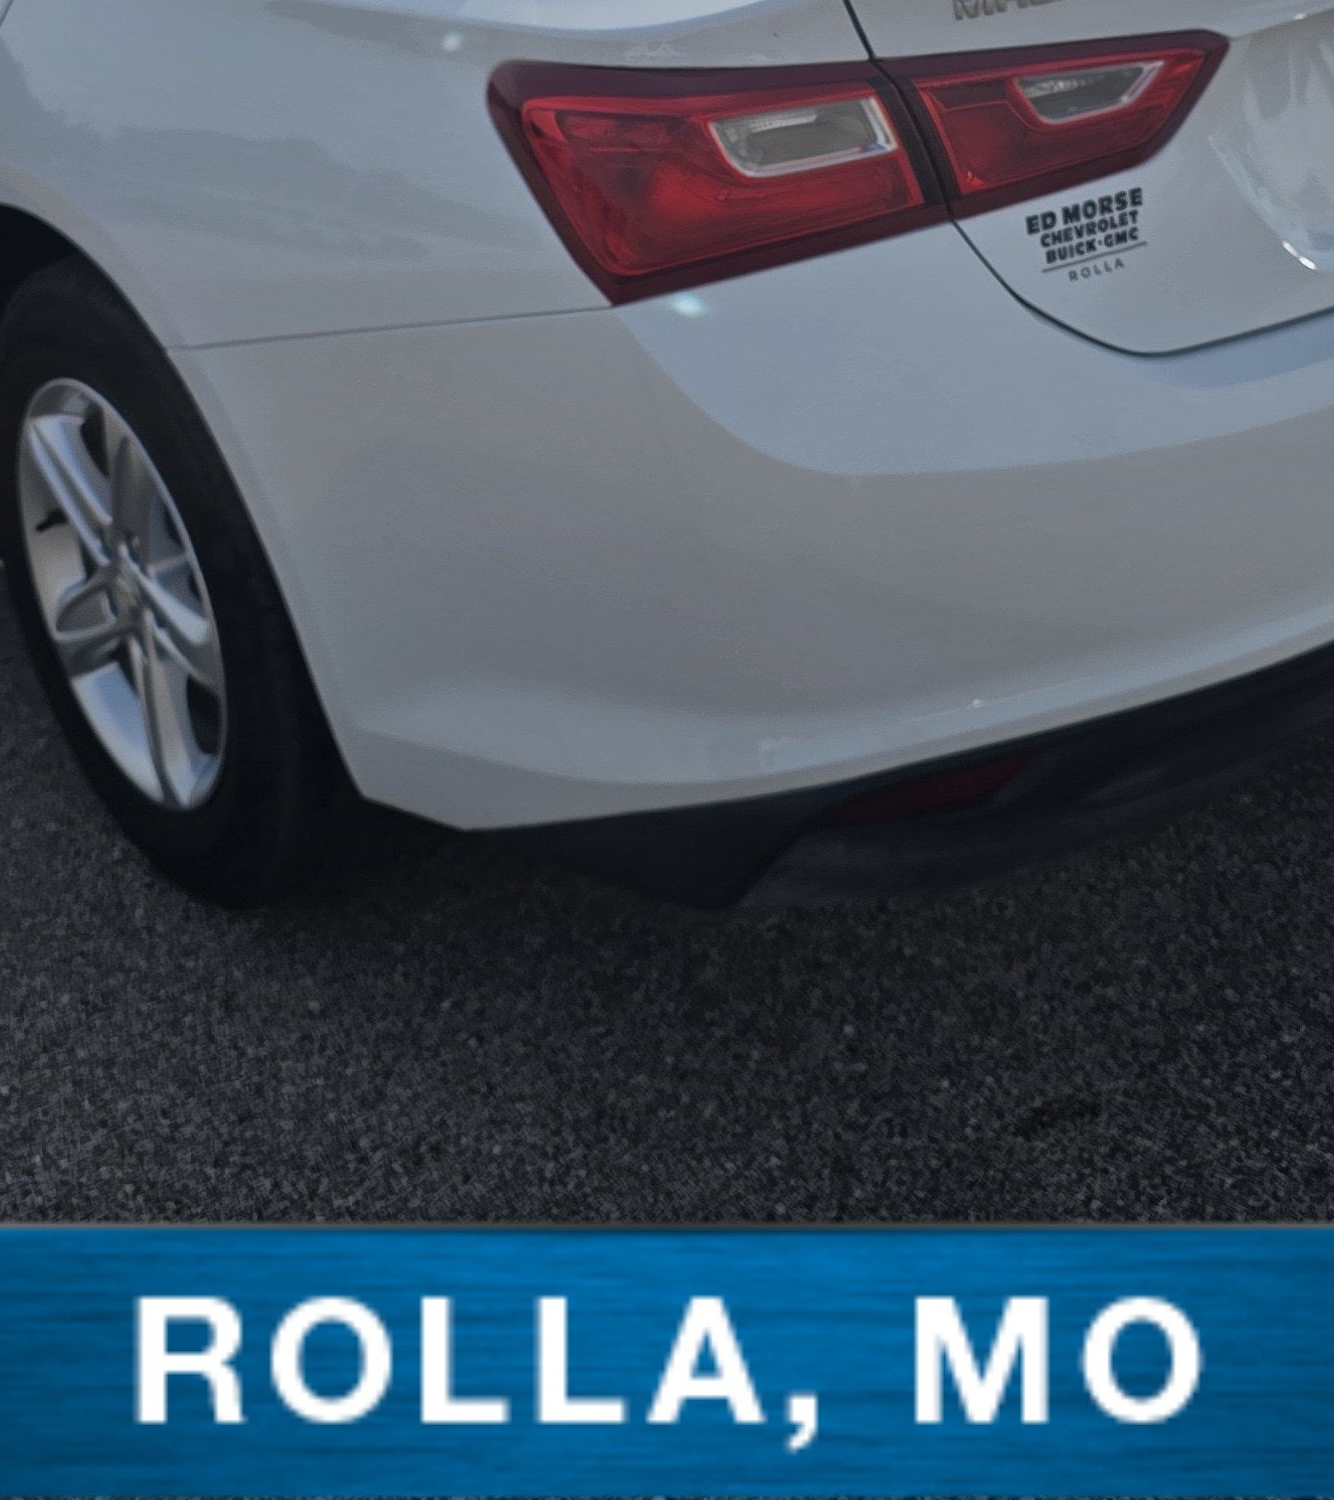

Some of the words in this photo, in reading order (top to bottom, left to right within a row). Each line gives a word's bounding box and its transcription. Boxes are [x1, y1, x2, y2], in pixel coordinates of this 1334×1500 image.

[1025, 210, 1057, 236] ED
[1061, 187, 1143, 226] MORSE
[1040, 208, 1139, 248] CHEVROLET
[1067, 257, 1125, 282] ROLLA
